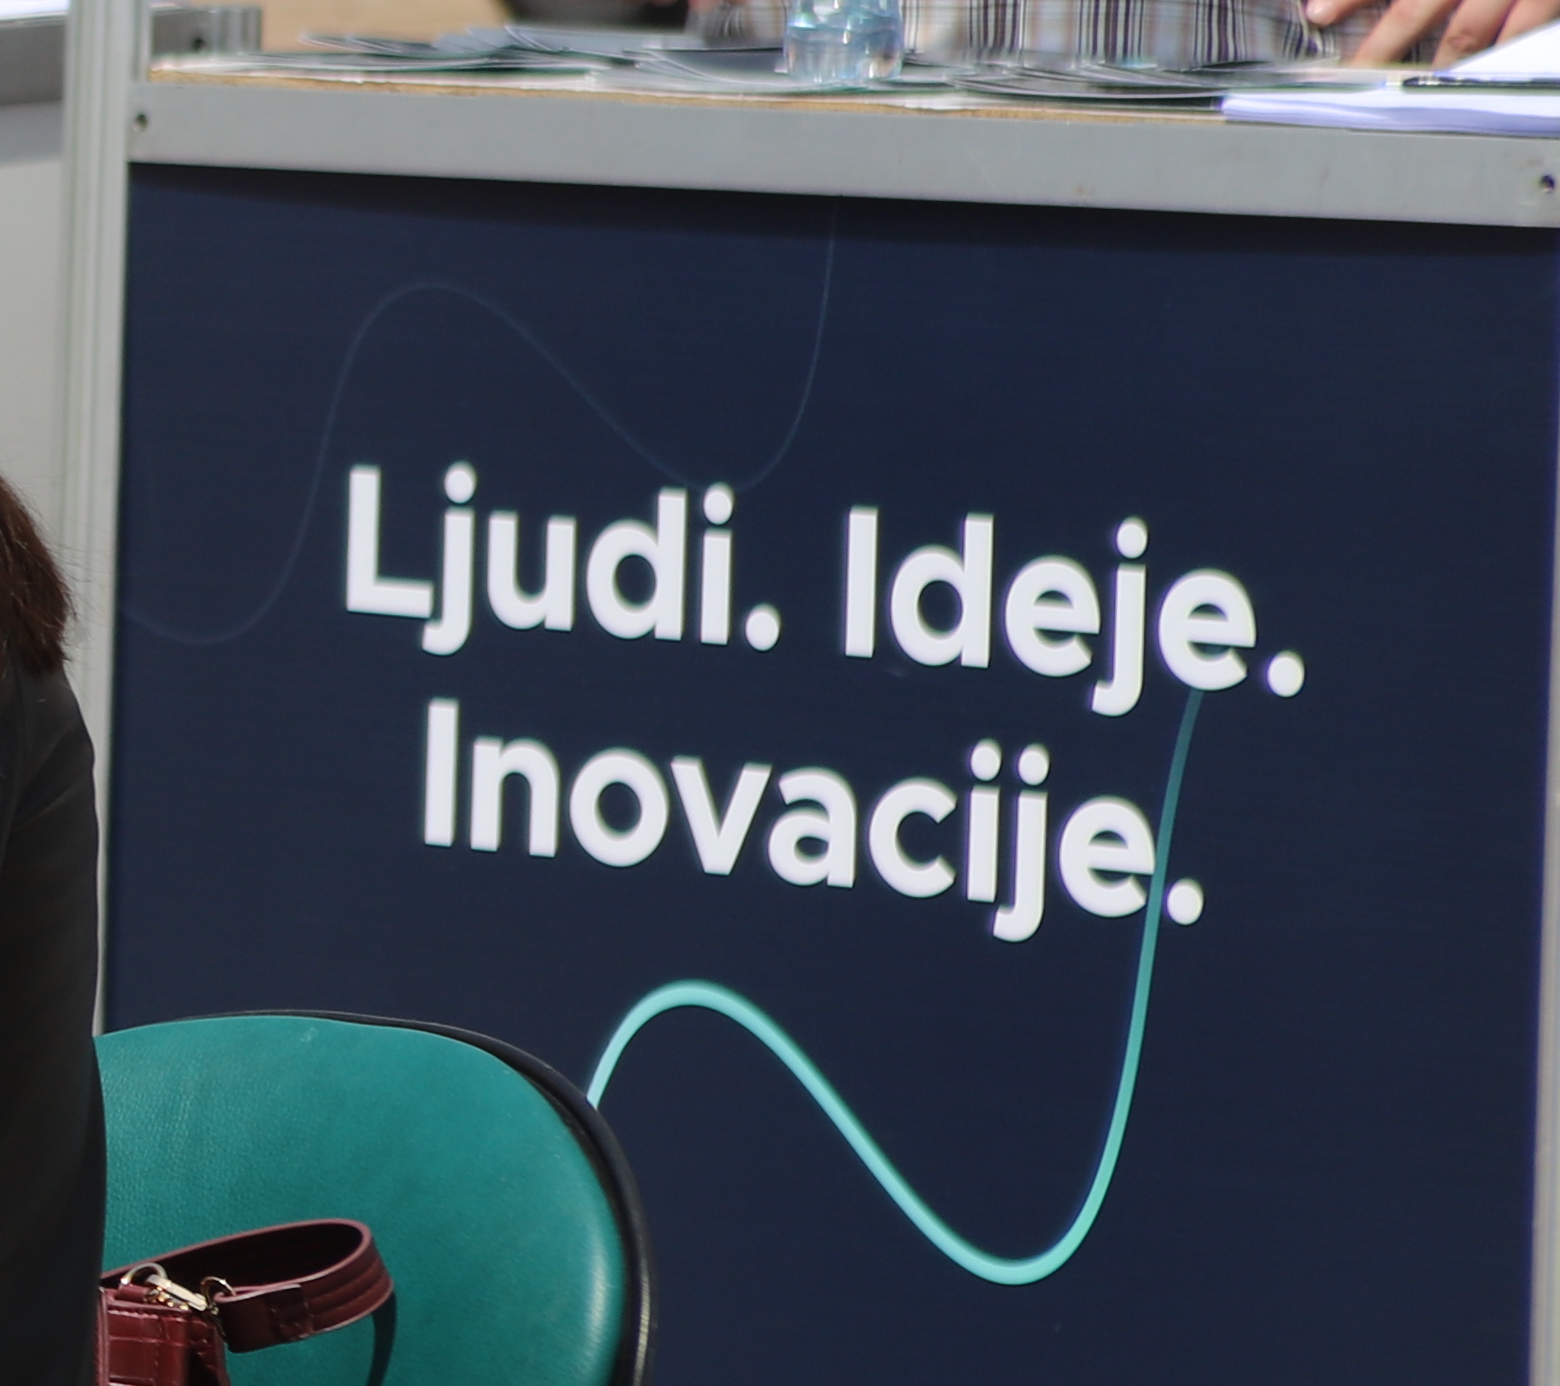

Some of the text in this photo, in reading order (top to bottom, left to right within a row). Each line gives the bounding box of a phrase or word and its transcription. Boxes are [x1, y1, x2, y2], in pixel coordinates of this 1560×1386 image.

[345, 461, 1305, 716] Ljudi. Ideje.
[423, 697, 1205, 942] Inovacije.
